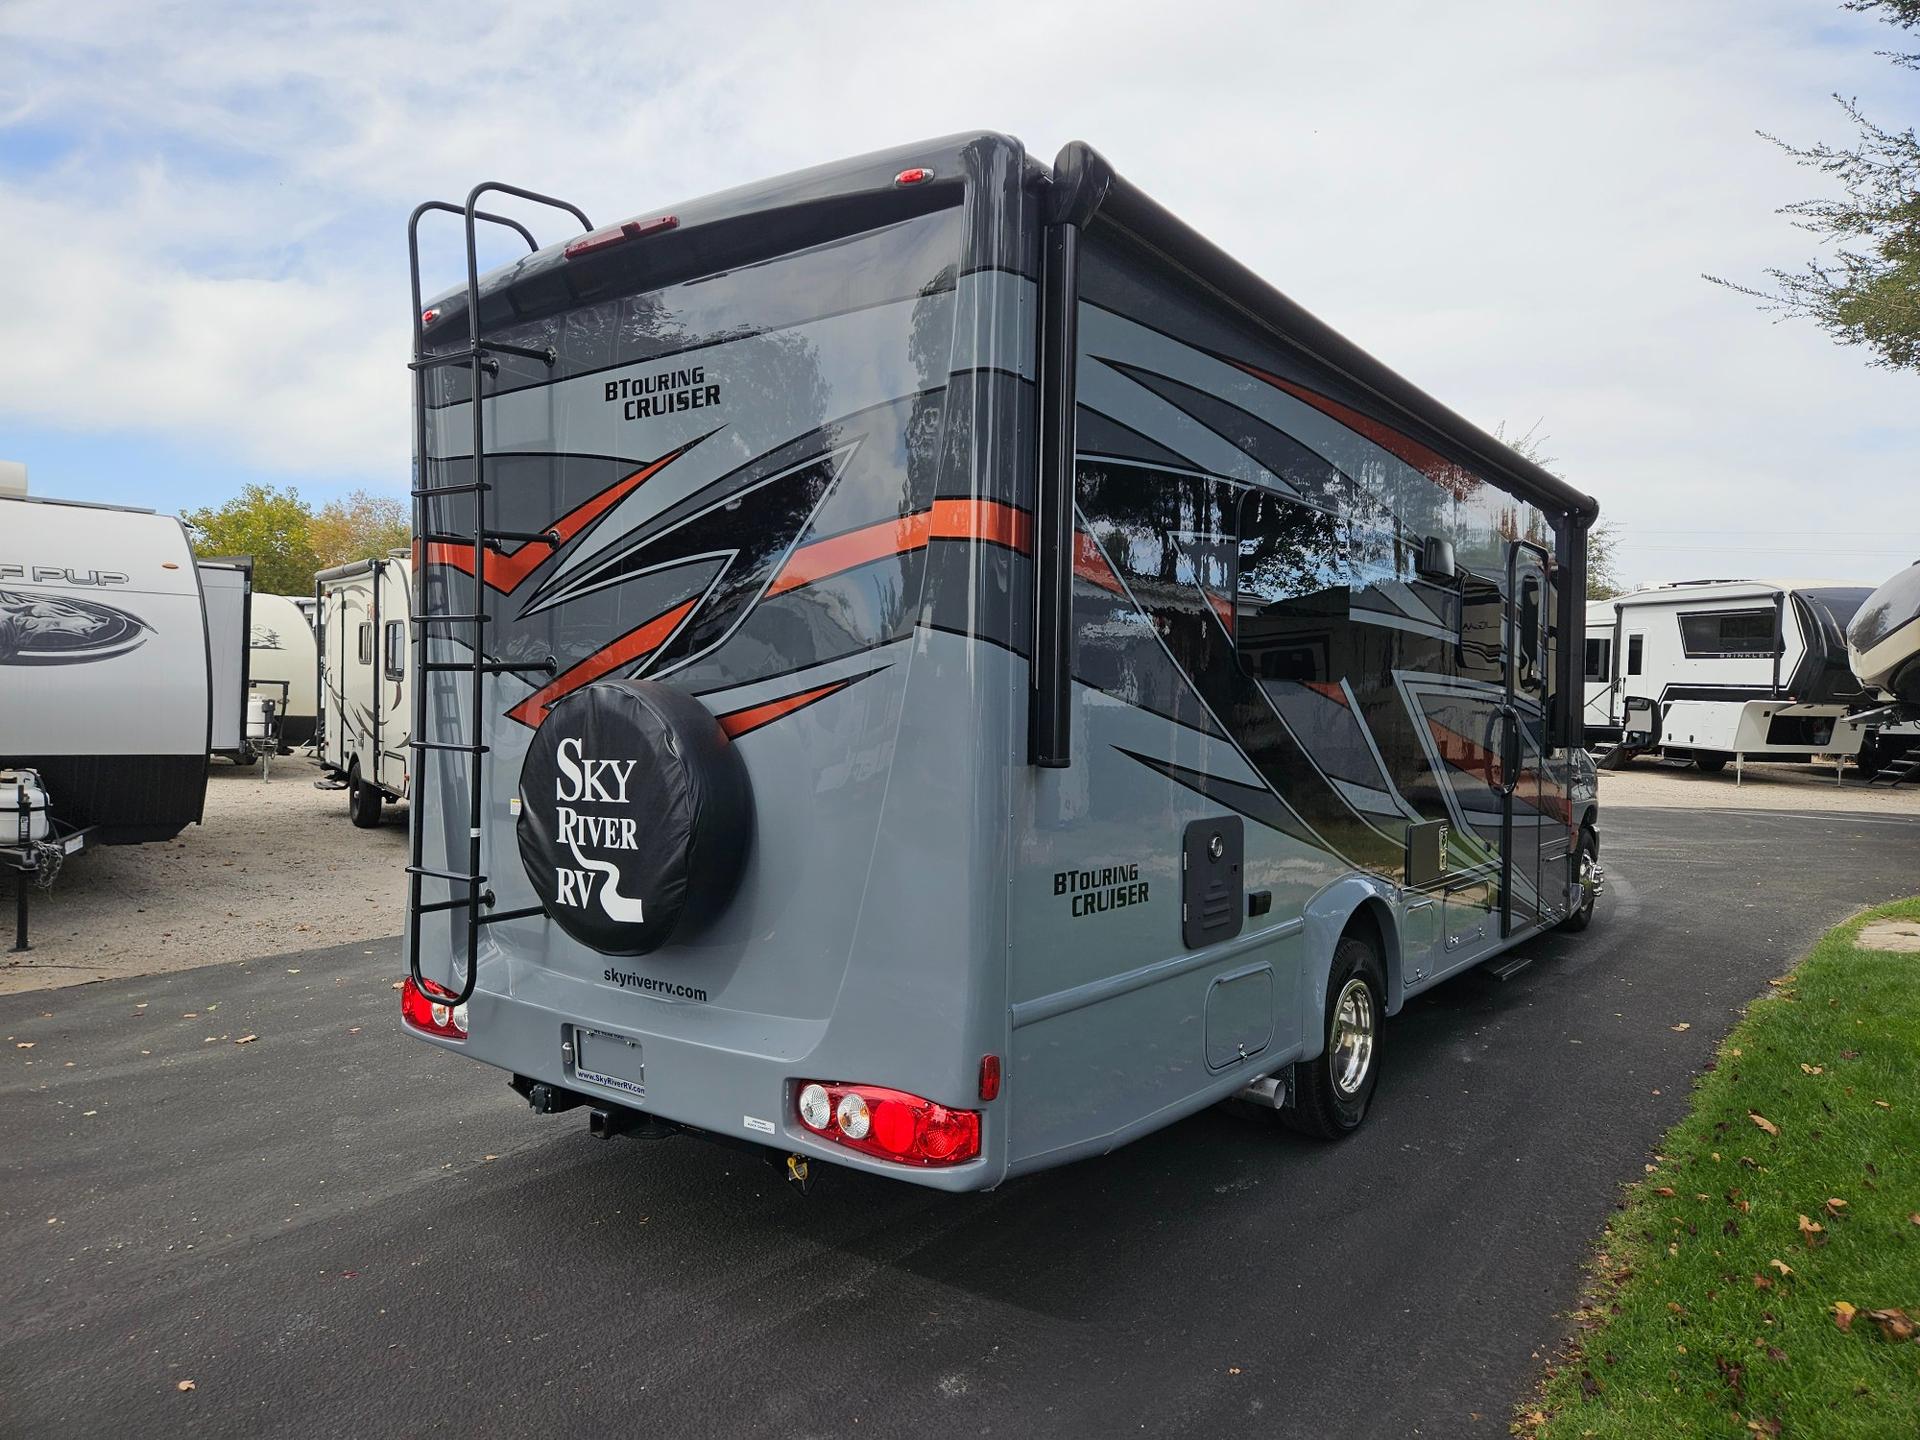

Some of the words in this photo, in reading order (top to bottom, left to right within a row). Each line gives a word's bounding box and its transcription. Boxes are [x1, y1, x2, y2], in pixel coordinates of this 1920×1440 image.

[624, 384, 721, 421] CRUISER
[32, 566, 129, 586] PUP
[555, 867, 596, 910] RV
[1072, 882, 1149, 918] CRUISER
[603, 967, 708, 1002] skyriverrv.com
